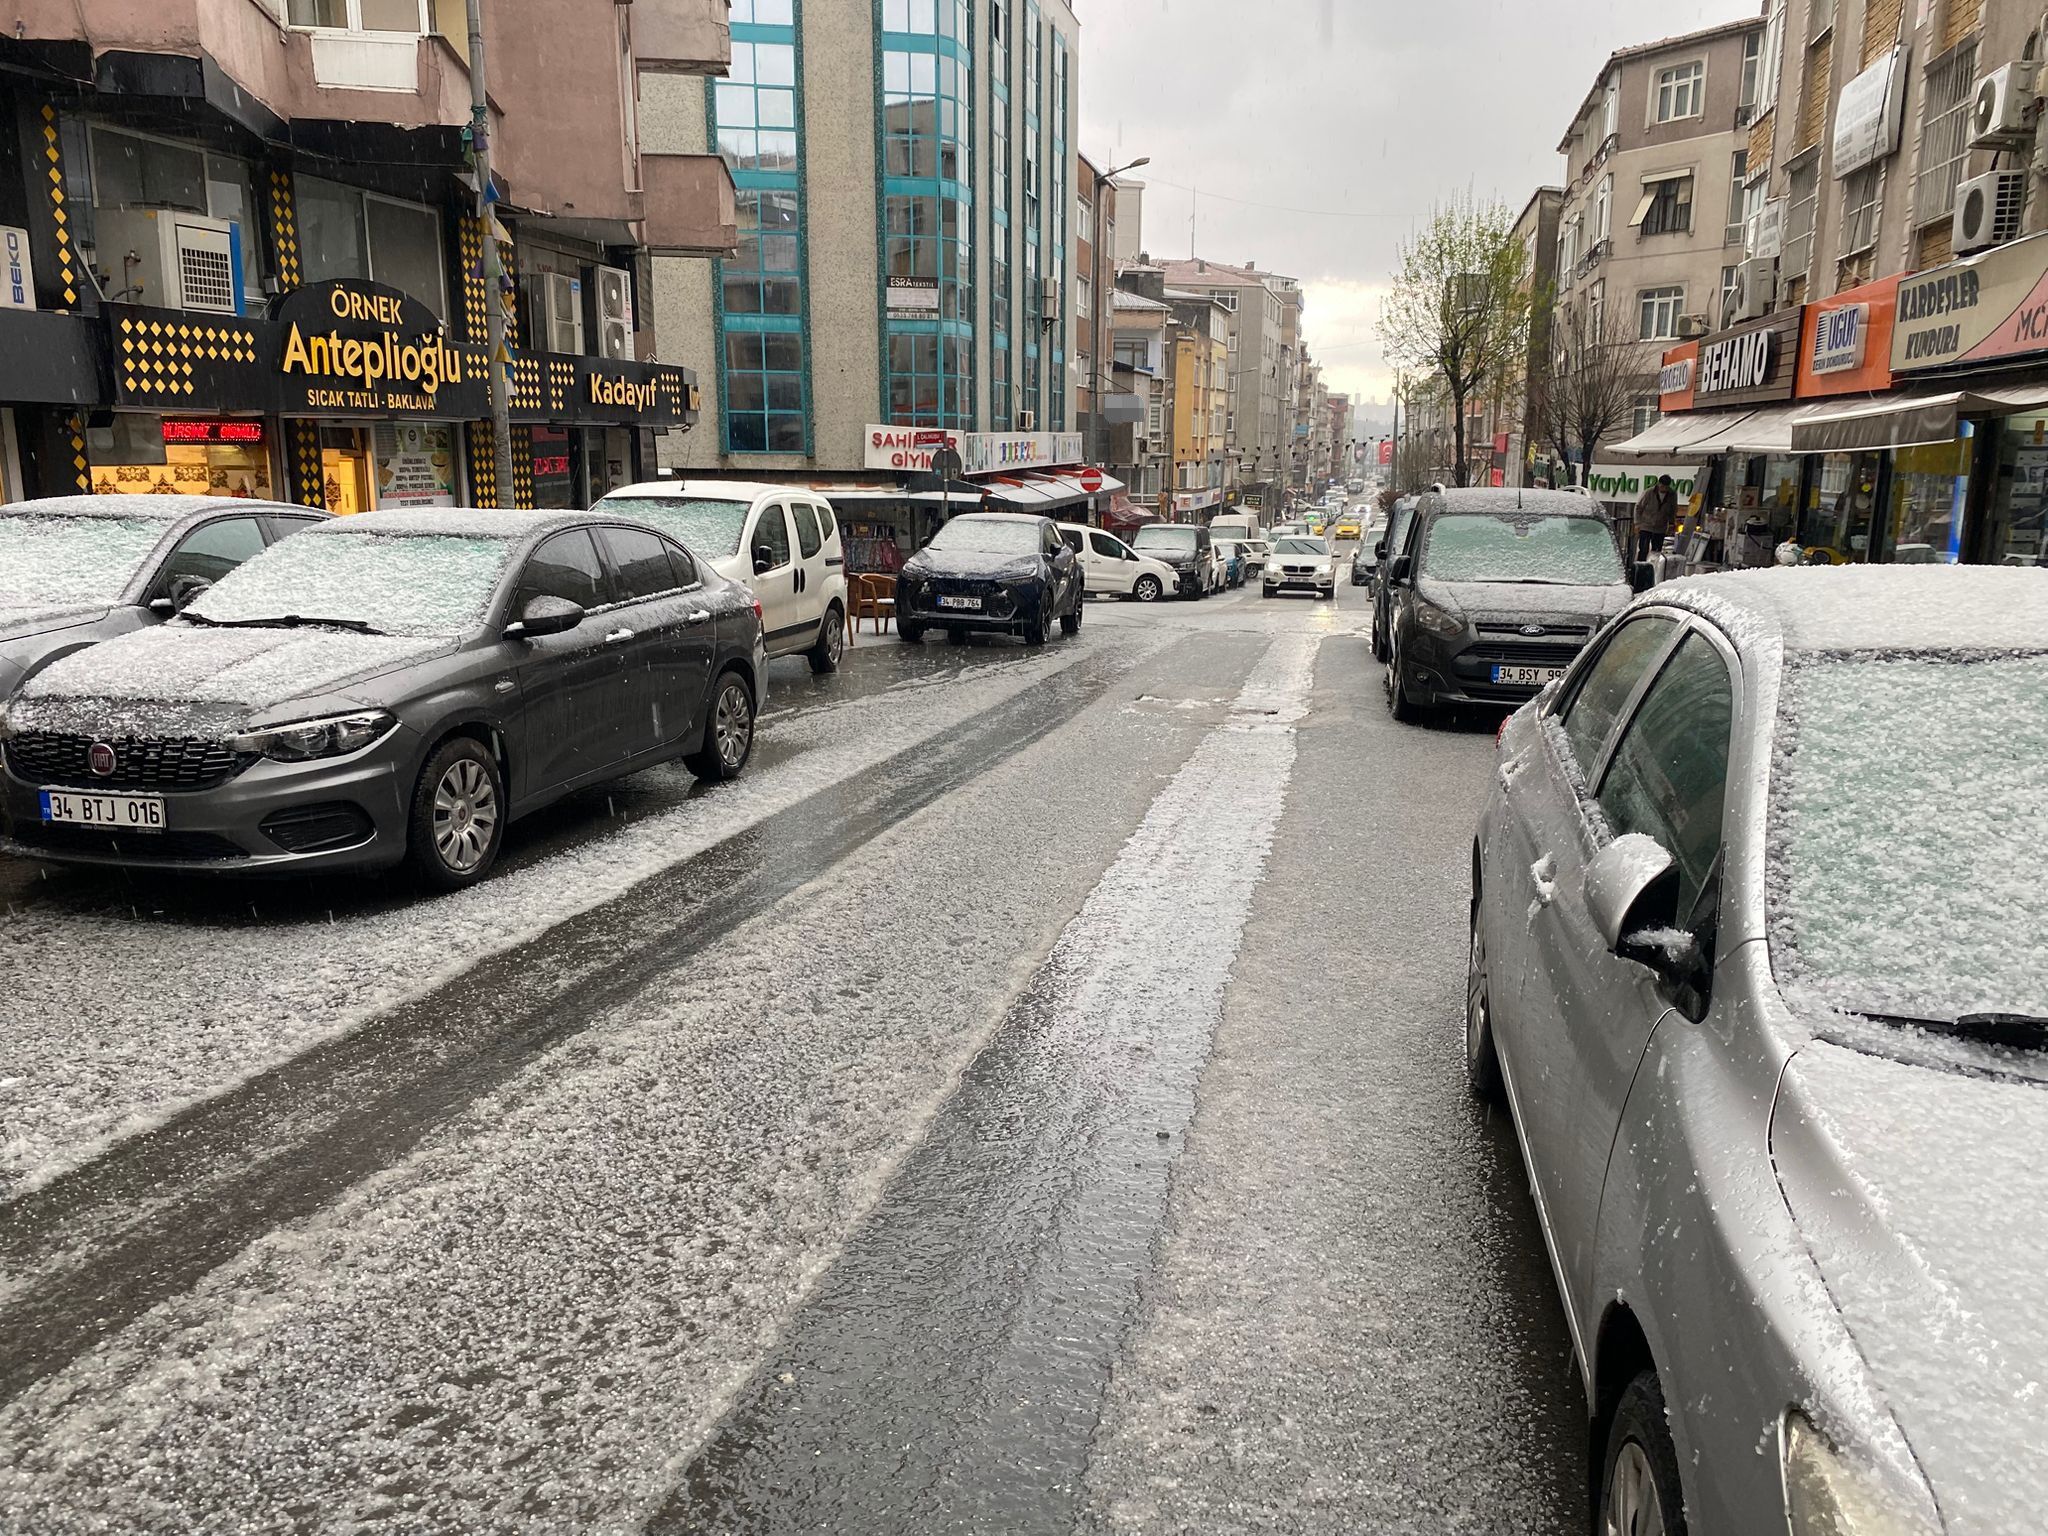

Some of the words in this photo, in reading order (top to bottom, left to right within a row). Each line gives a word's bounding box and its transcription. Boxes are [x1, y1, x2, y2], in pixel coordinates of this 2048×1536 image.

[6, 232, 25, 304] BEKO
[890, 277, 913, 287] ESRA
[331, 283, 403, 325] ÖRNEK
[1899, 269, 1980, 323] KARDEŞLER
[1827, 308, 1858, 351] UĞUR
[1904, 323, 1961, 360] KUNDURA
[282, 320, 462, 394] Anteplioğlu
[1701, 328, 1768, 393] BEHAMO
[307, 389, 345, 407] SICAK
[347, 391, 379, 409] TATLI
[387, 393, 435, 410] BAKLAVA
[590, 372, 657, 413] Kadayıf
[872, 432, 957, 450] ŞAHİR
[1589, 472, 1638, 497] Yayla
[1500, 668, 1513, 680] 34
[1519, 669, 1540, 681] BSY
[92, 753, 110, 768] FIAT
[52, 796, 73, 818] 34
[82, 798, 116, 821] BTJ
[128, 801, 161, 824] 016
